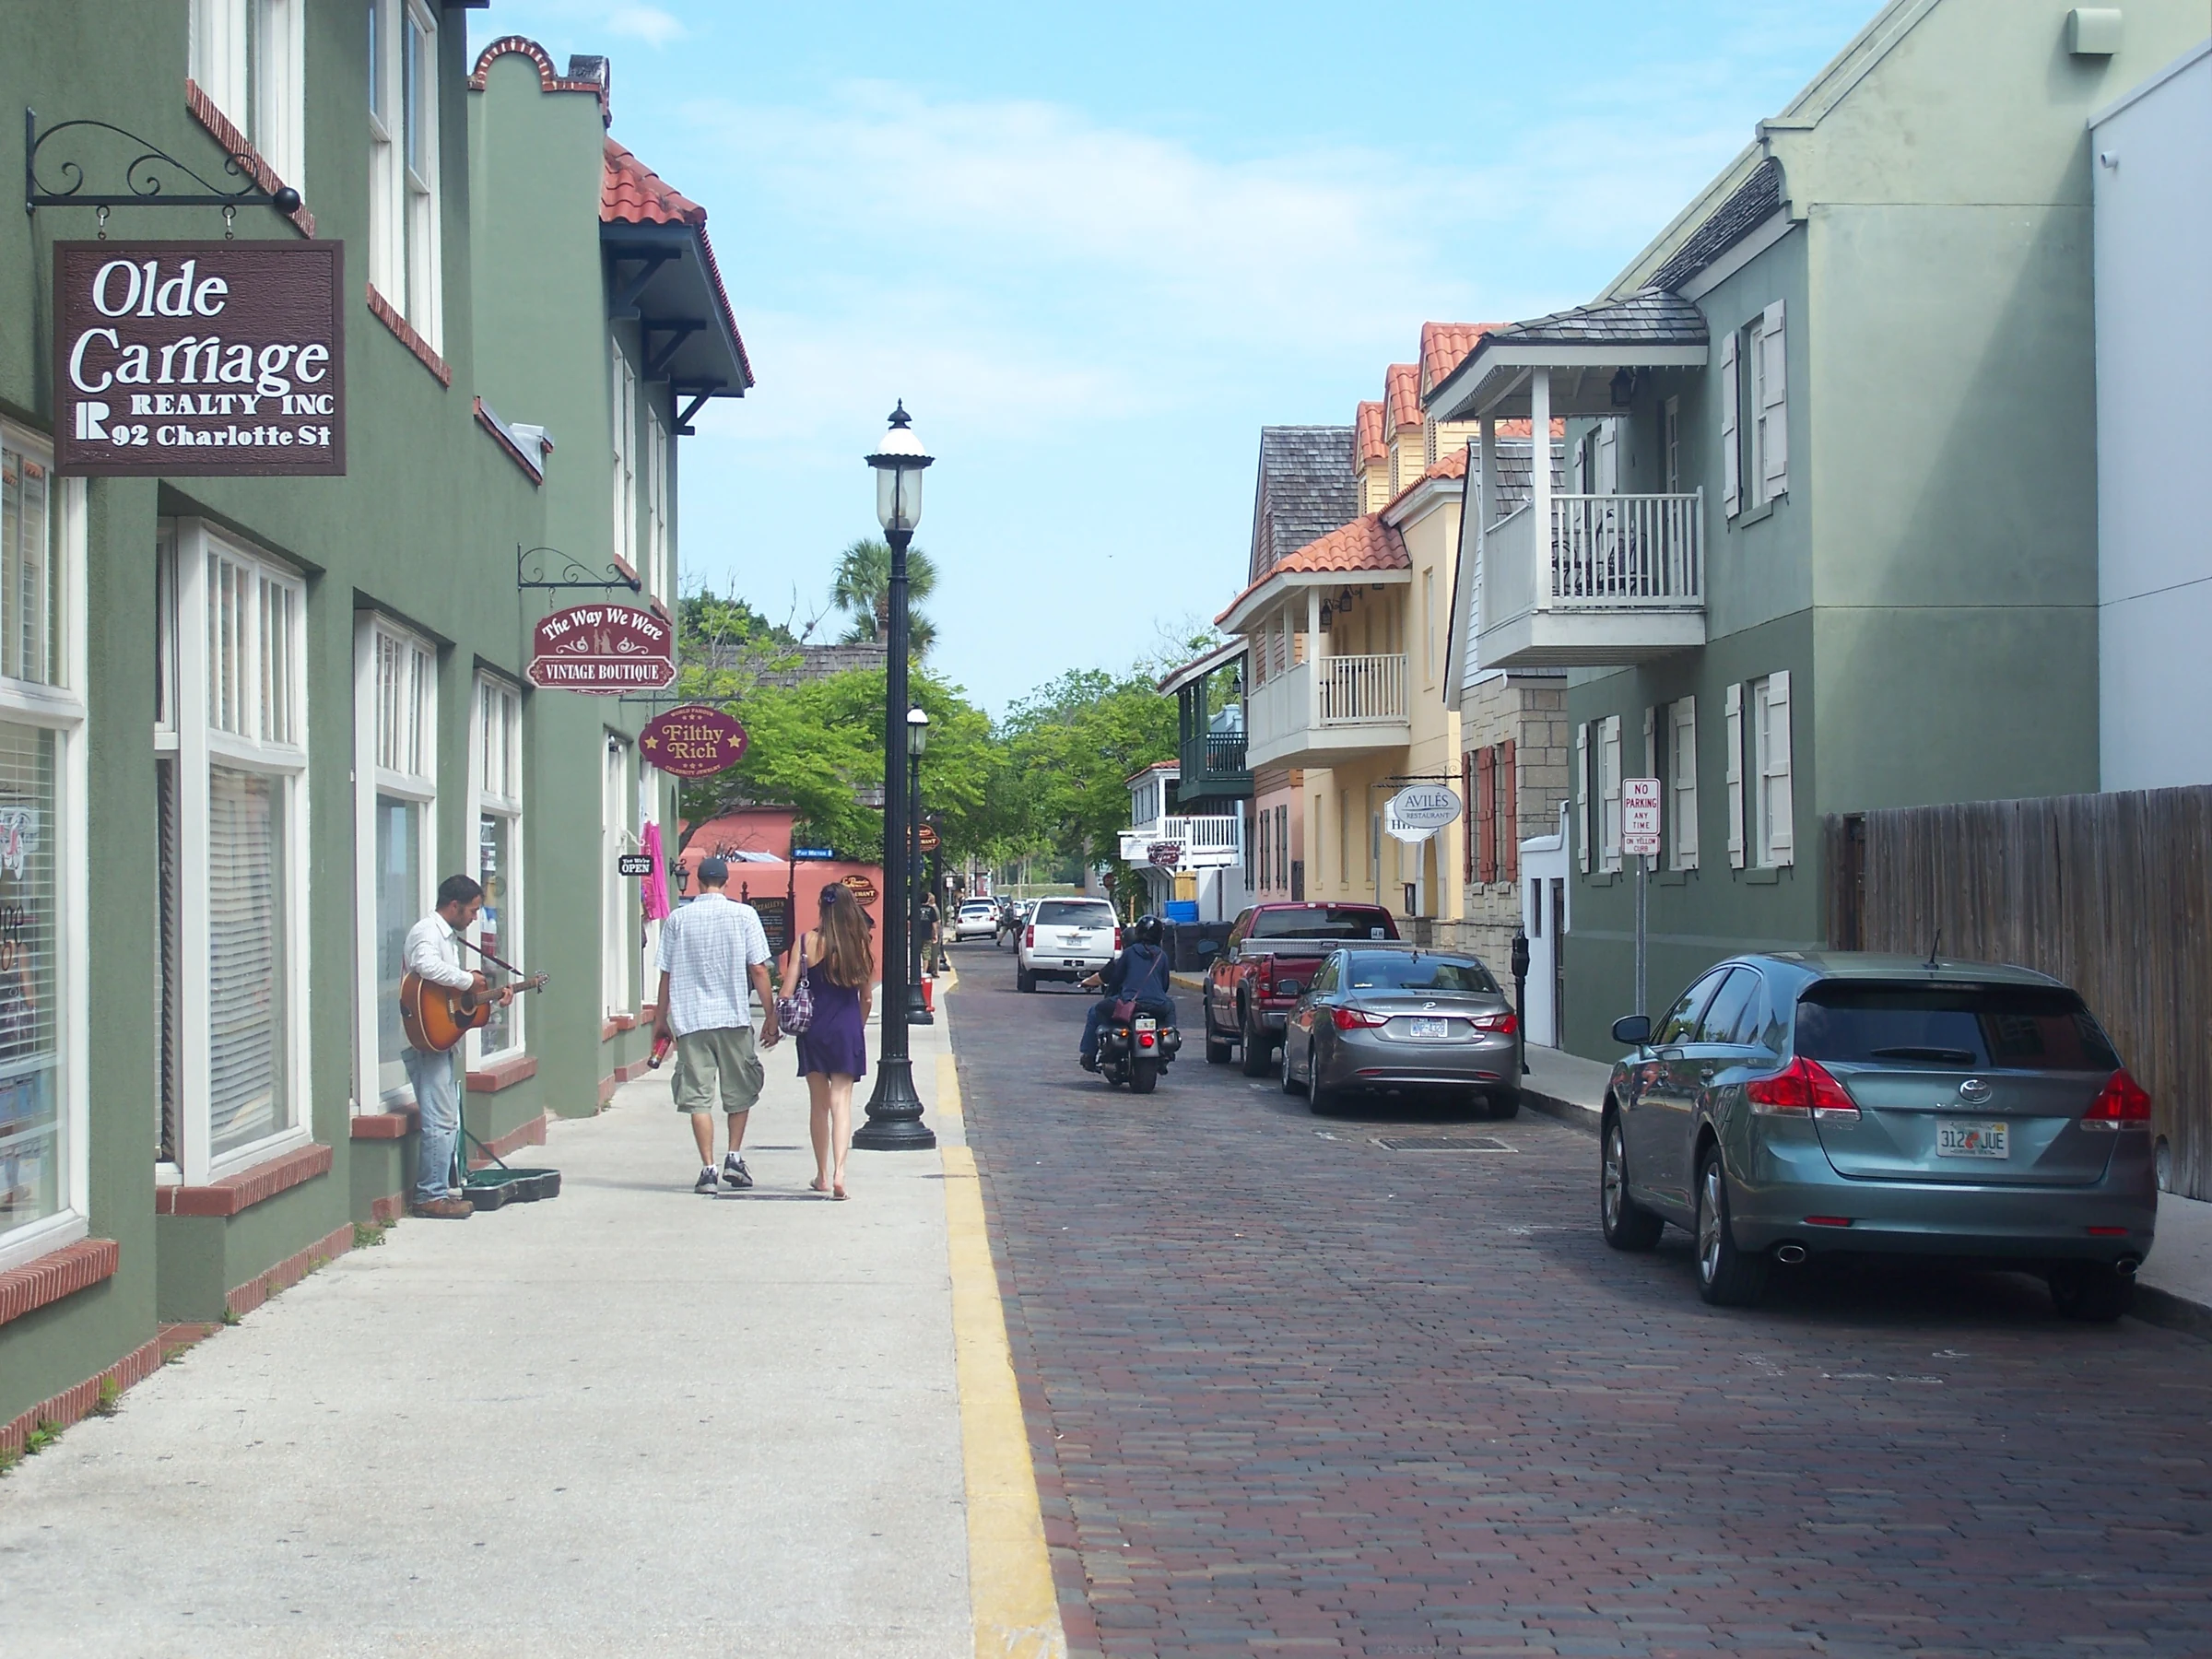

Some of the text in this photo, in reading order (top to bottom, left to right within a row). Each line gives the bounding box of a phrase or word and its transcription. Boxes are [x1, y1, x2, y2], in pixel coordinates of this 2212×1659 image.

[92, 259, 229, 317] Olde
[69, 328, 329, 397] Carriage
[130, 394, 335, 416] REALTY INC
[111, 424, 331, 448] 92 Charlotte St
[541, 607, 664, 641] The Way We Were
[546, 664, 659, 682] VINTAGE BOUTIQUE
[670, 708, 690, 717] WORLD
[662, 724, 724, 744] Filthy
[667, 742, 717, 759] Rich
[1634, 784, 1648, 794] NO
[1626, 798, 1657, 808] PARKING
[621, 864, 650, 873] OPEN
[1941, 1131, 2004, 1149] 312 JUE
